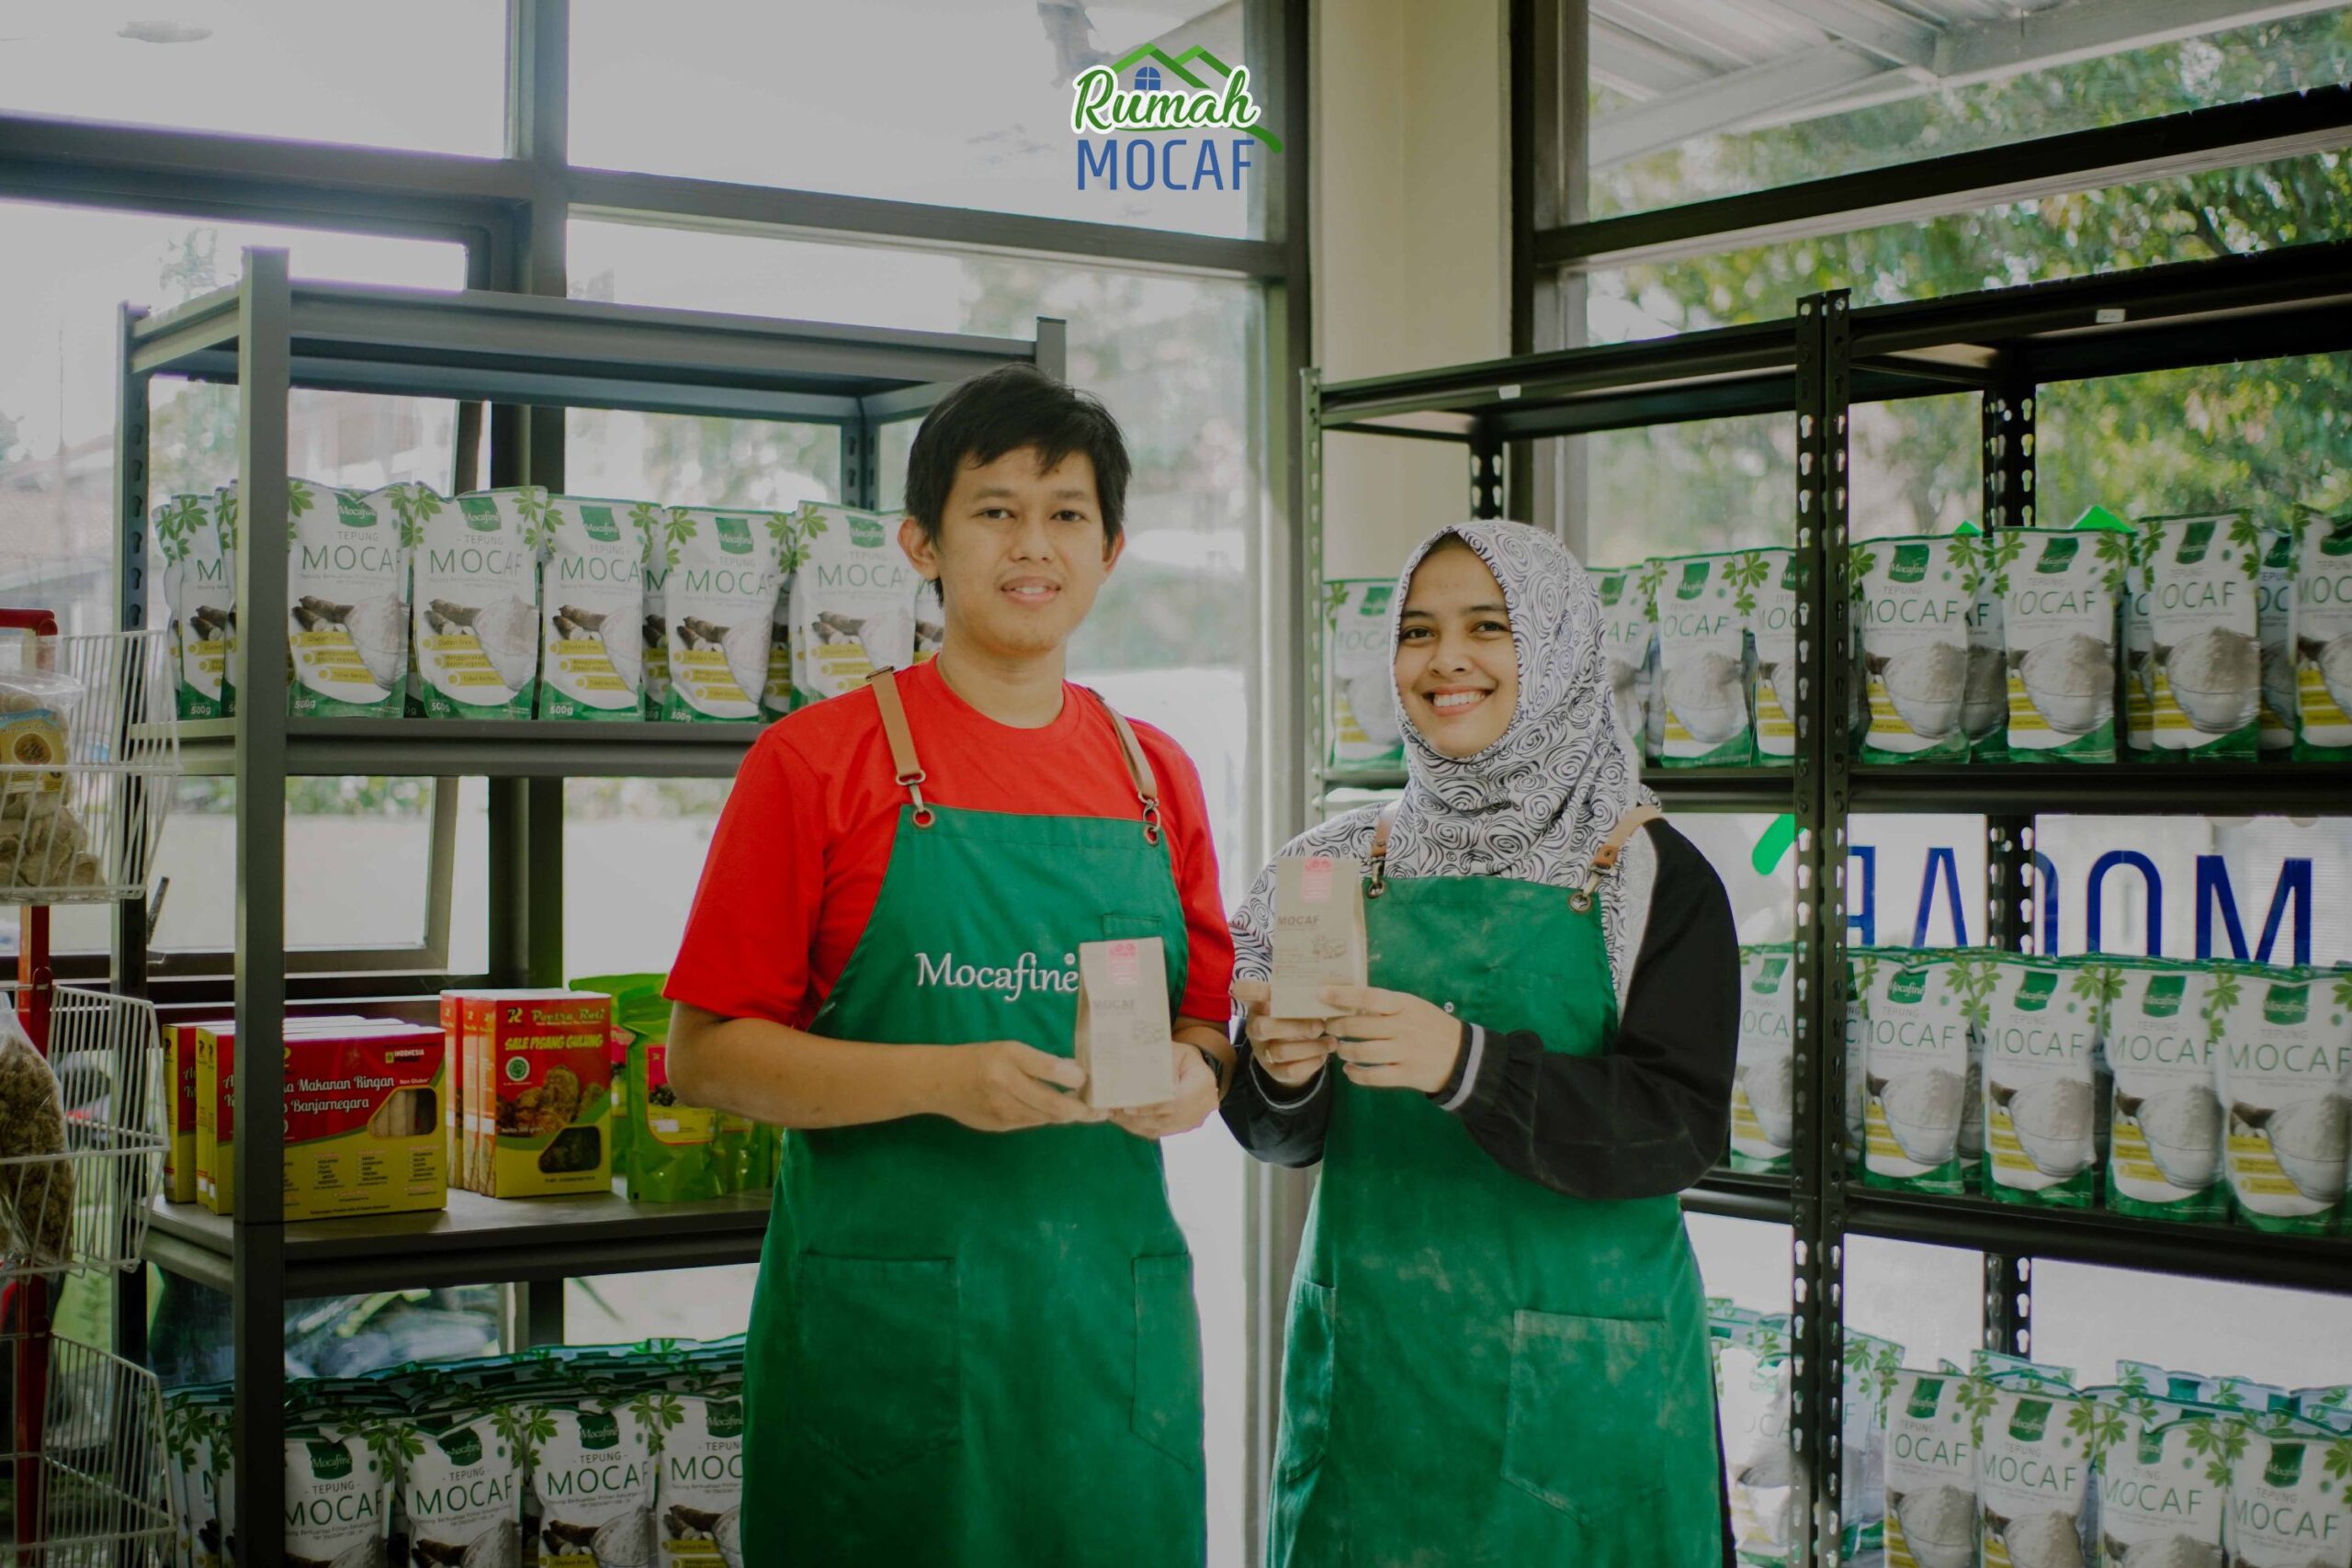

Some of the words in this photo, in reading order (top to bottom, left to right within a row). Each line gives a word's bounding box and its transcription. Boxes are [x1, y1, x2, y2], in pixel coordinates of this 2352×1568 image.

[337, 530, 379, 542] TEPUNG
[465, 534, 504, 546] TEPUNG
[588, 544, 626, 556] TEPUNG
[849, 551, 888, 561] TEPUNG
[429, 548, 523, 577] MOCAF
[718, 557, 757, 568] TEPUNG
[817, 563, 910, 589] MOCA
[1883, 586, 1924, 596] TEPUNG
[2156, 581, 2238, 610] OCAF
[189, 704, 212, 716] 500g
[294, 699, 316, 711] 500g
[431, 702, 450, 714] 500g
[549, 704, 574, 716] 500g
[671, 711, 692, 724] 500g
[1277, 915, 1320, 927] MOCAF
[914, 951, 1080, 1002] Mocafine
[1093, 998, 1136, 1010] MOCAF
[1882, 1006, 1920, 1019] TEPUNG
[393, 1048, 426, 1057] INDONESIA
[2227, 1043, 2352, 1074] MOCAF
[297, 1077, 352, 1092] Makanan
[353, 1075, 394, 1091] Ringan
[289, 1097, 370, 1116] Banjarnegara
[579, 1450, 622, 1464] TEPUNG
[1890, 1433, 1969, 1468] OCAF
[448, 1466, 486, 1482] TEPUNG
[547, 1461, 649, 1497] MOCAF
[1983, 1454, 2077, 1493] MOCAF
[312, 1480, 356, 1495] TEPUNG
[415, 1473, 513, 1516] MOCAF
[2103, 1474, 2204, 1516] MOCAF
[2256, 1486, 2299, 1505] TEPUNG
[2233, 1495, 2341, 1541] MOCAF
